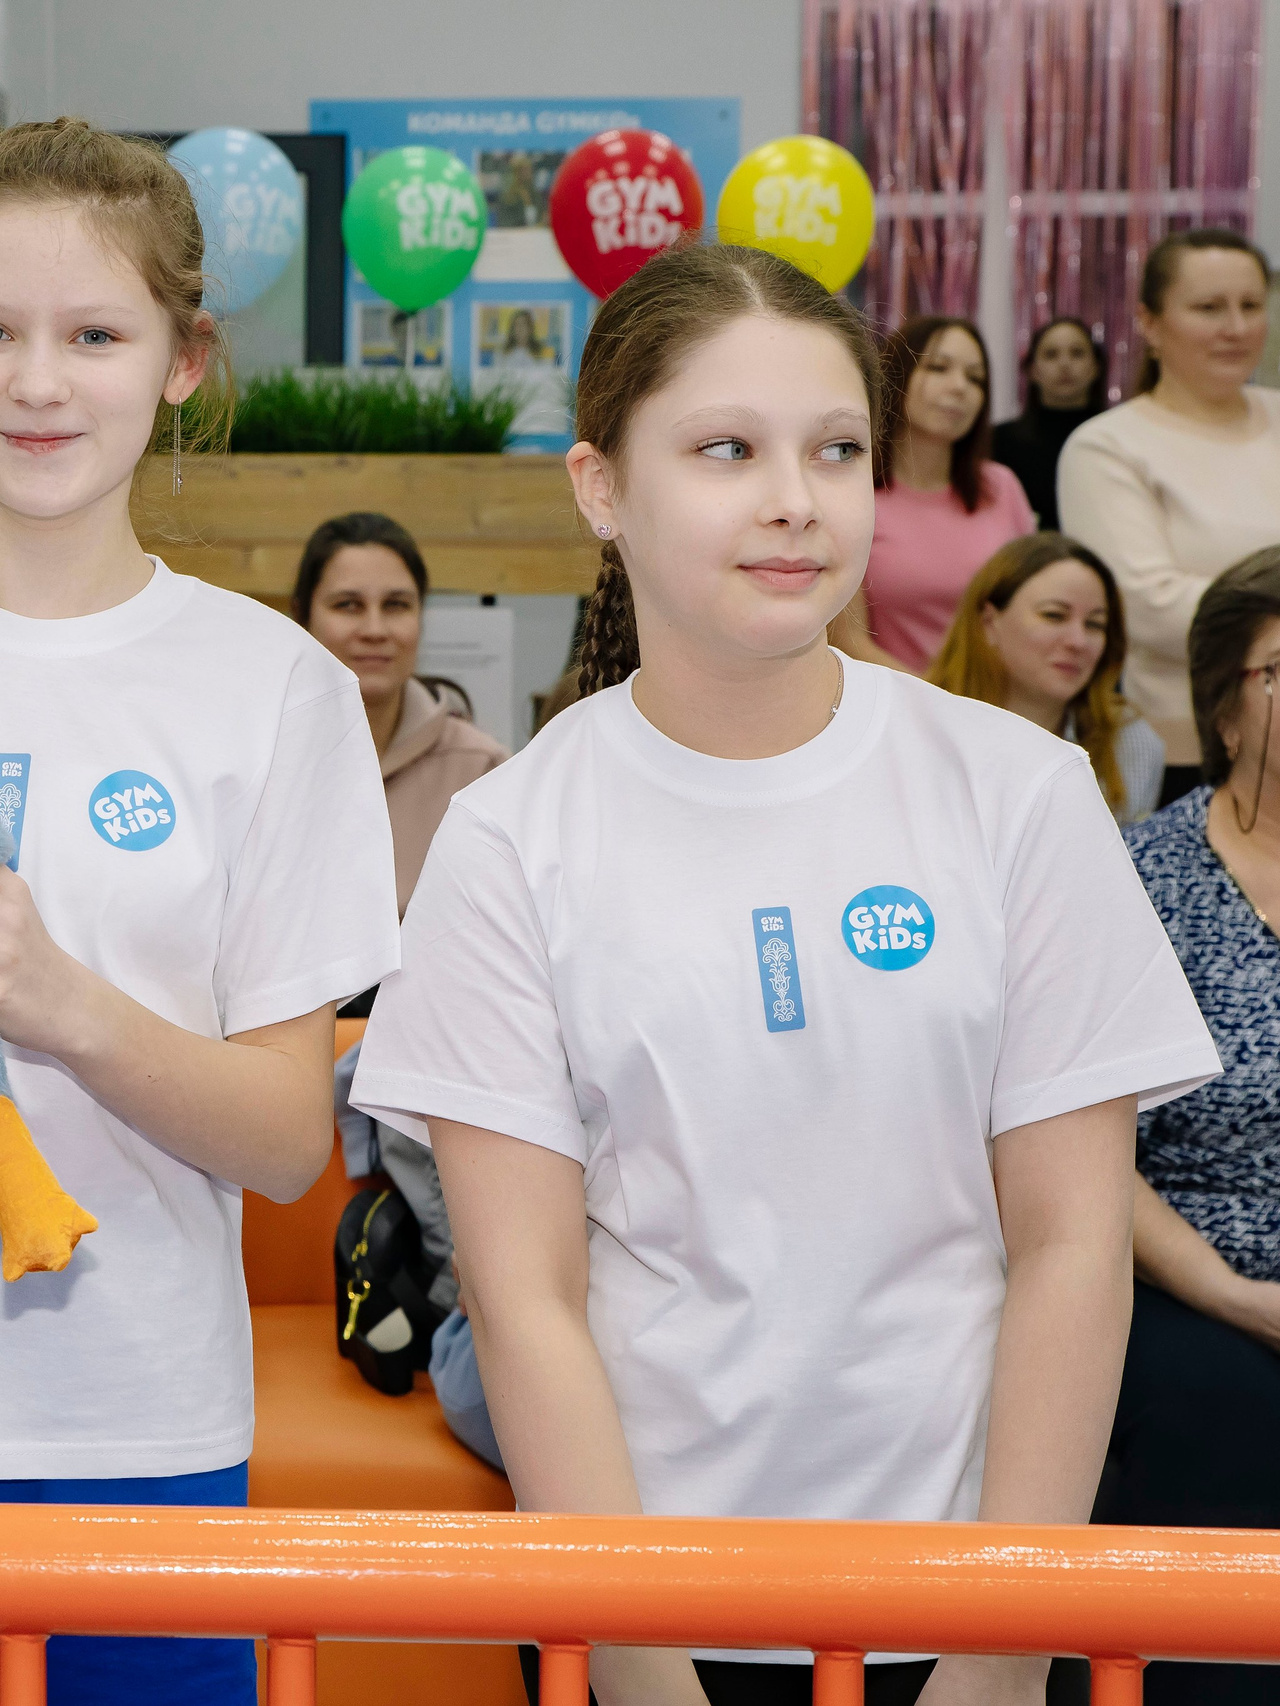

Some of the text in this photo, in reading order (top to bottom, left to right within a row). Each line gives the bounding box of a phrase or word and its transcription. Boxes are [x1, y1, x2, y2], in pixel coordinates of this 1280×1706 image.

[395, 181, 479, 219] GYM
[586, 175, 684, 217] GYM
[753, 174, 842, 217] GYM
[2, 761, 22, 771] GYM
[94, 782, 163, 820] GYM
[102, 807, 171, 843] KiDs
[760, 916, 783, 925] GYM
[848, 902, 925, 930] GYM
[852, 926, 927, 954] KiDs
